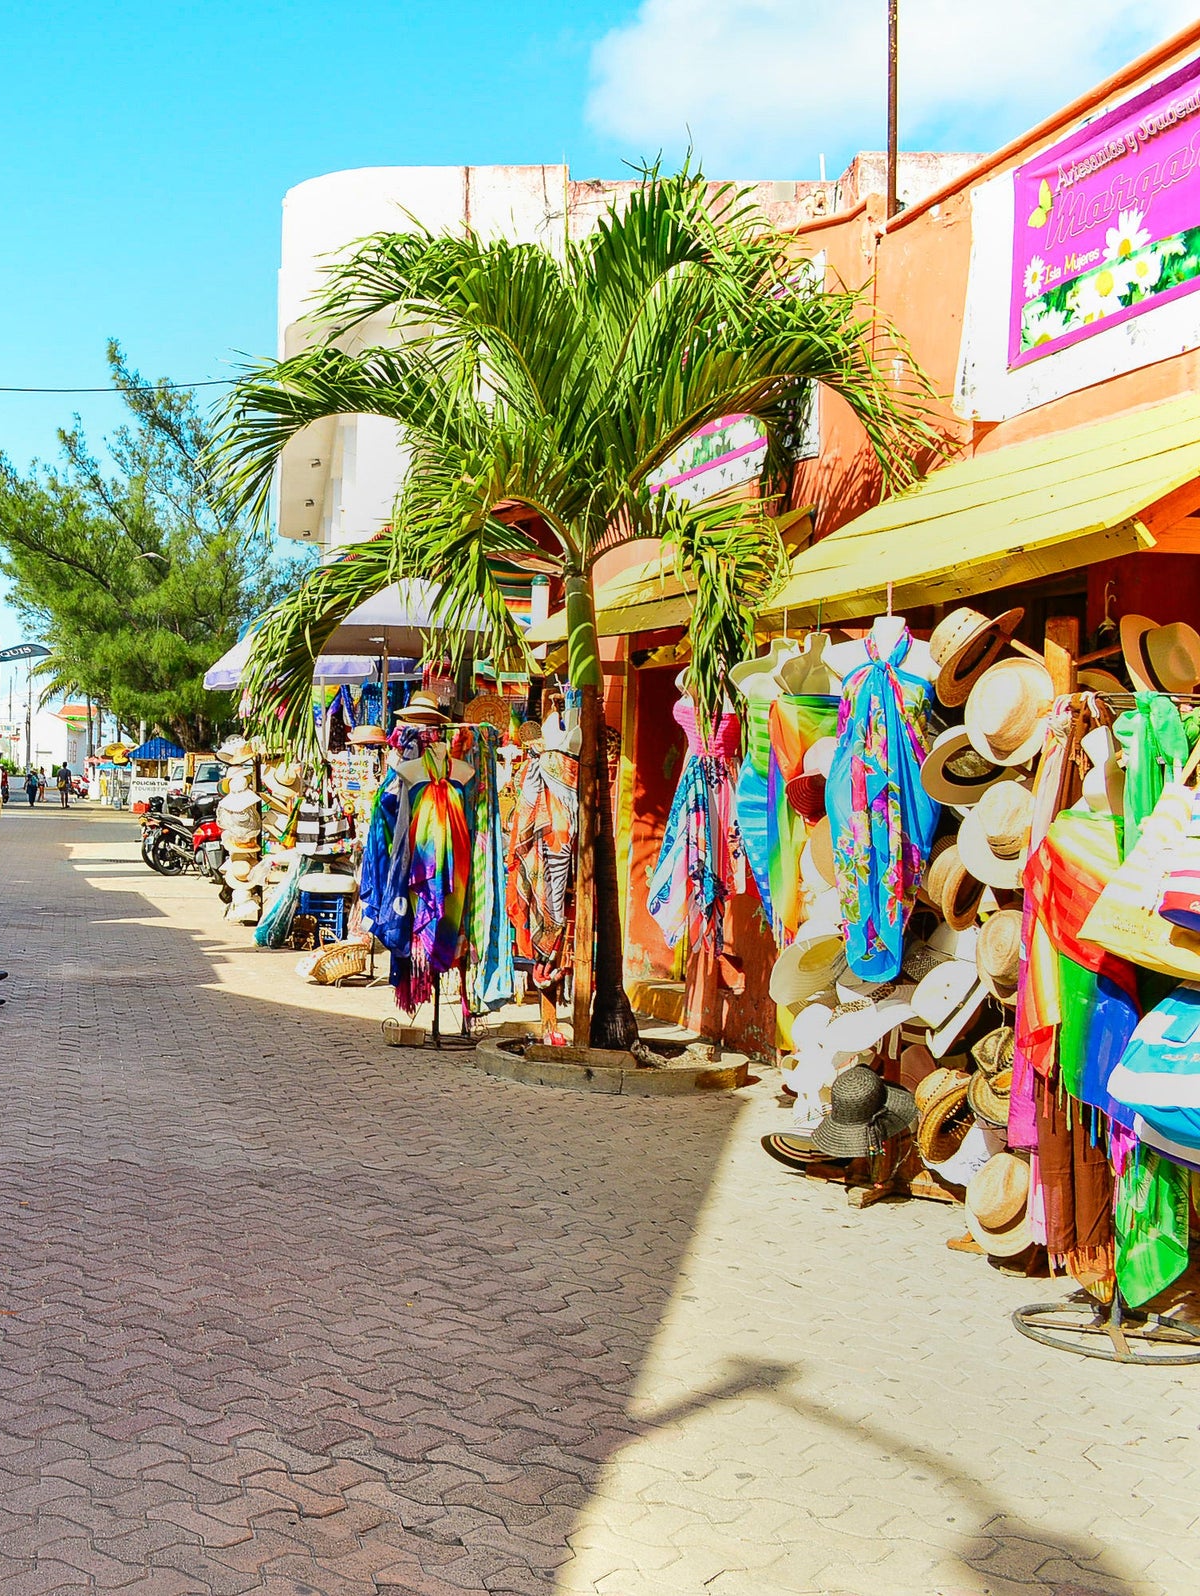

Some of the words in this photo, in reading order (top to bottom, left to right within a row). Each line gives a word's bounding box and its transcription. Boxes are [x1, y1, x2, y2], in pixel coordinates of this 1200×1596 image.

[1055, 137, 1126, 192] Artesanias
[1124, 131, 1139, 153] y
[1044, 264, 1062, 285] Isla
[1064, 248, 1100, 275] Mujeres
